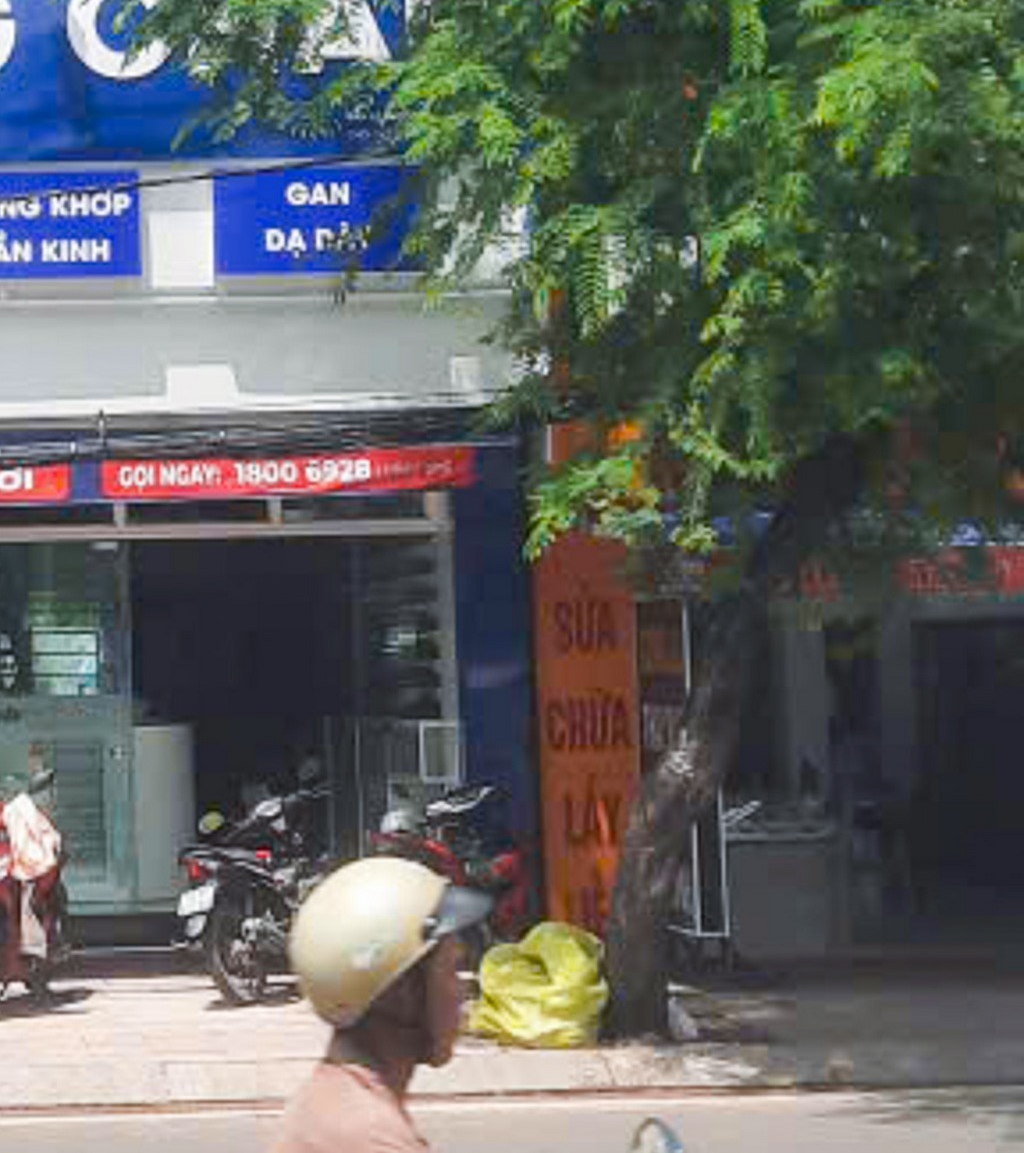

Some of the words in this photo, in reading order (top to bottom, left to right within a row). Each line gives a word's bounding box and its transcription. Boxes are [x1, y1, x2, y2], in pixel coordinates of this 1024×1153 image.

[285, 182, 349, 205] GAN
[42, 239, 111, 263] KINH
[233, 462, 296, 485] 1800
